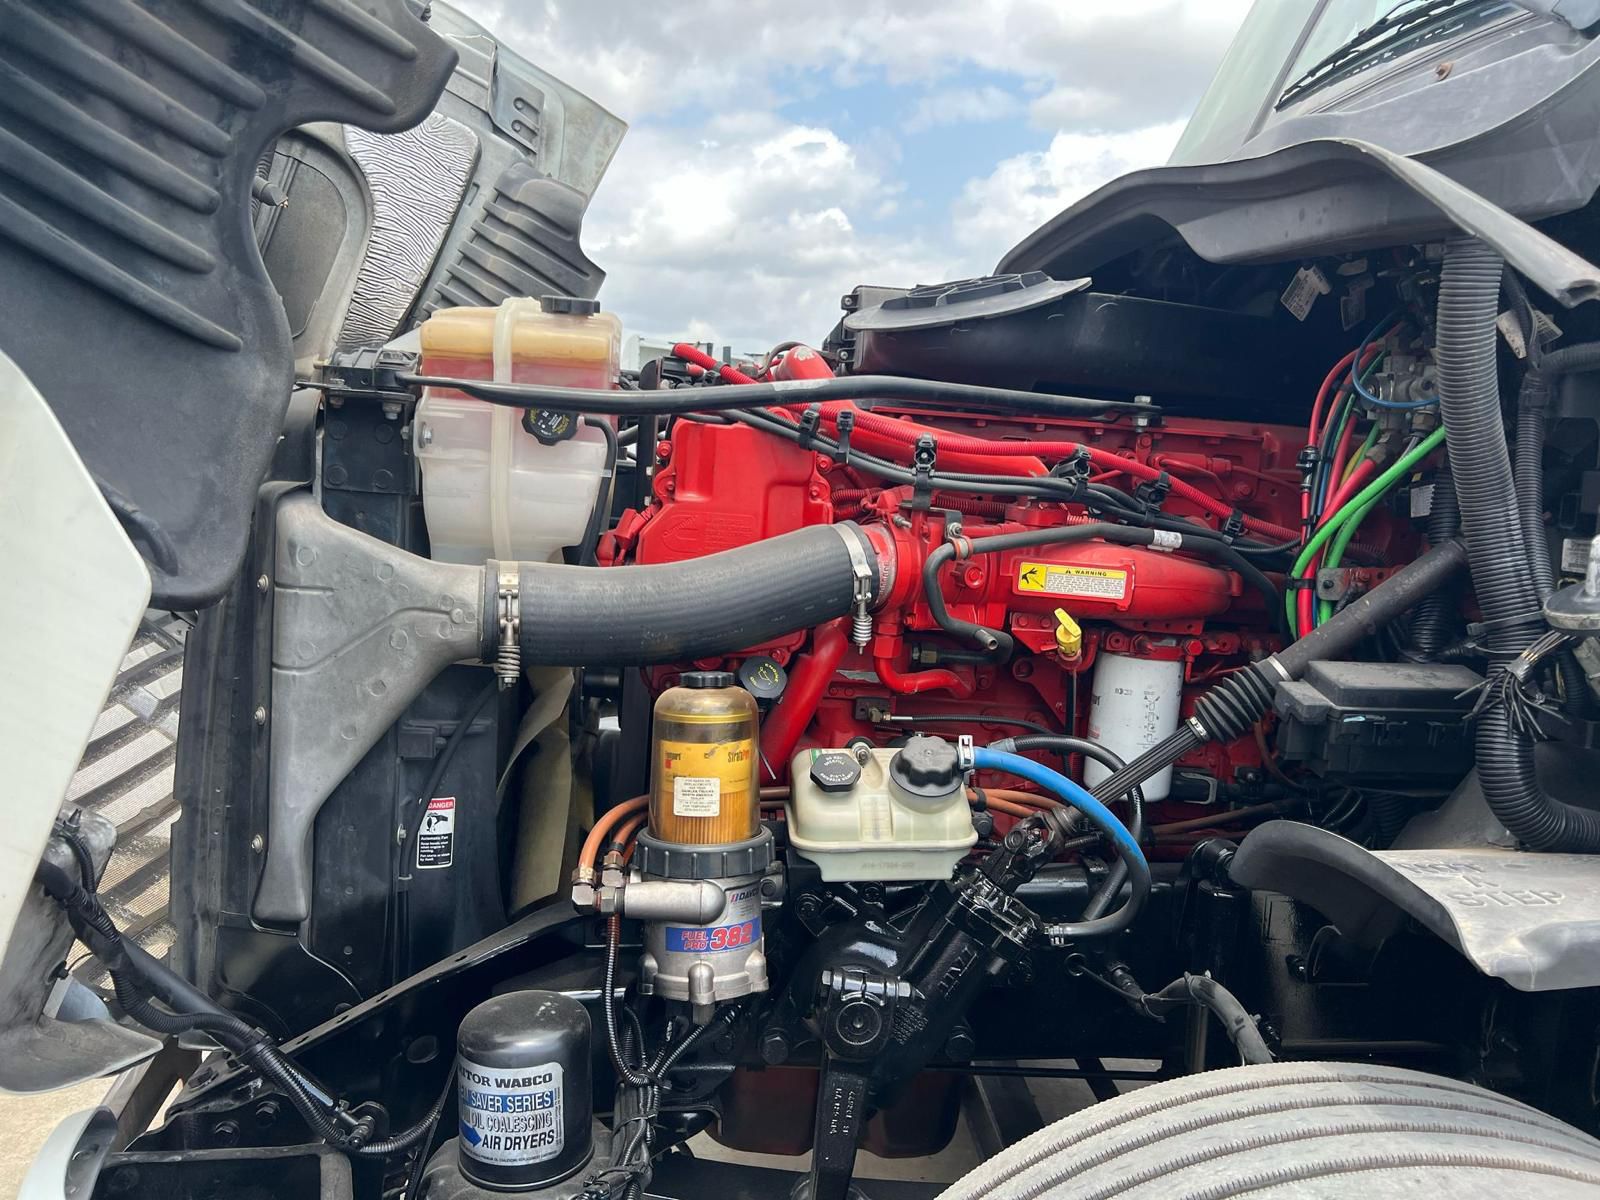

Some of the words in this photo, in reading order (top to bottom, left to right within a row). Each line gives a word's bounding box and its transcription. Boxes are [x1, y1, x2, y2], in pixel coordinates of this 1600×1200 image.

[764, 663, 779, 683] ENGINE
[428, 801, 454, 809] DANGER
[1447, 889, 1566, 907] STEP
[681, 930, 709, 940] FUEL
[710, 923, 754, 950] 382
[684, 940, 708, 950] PRO
[495, 1073, 553, 1088] WABCO
[471, 1091, 504, 1113] SAVER
[507, 1091, 553, 1114] SERIES
[470, 1110, 485, 1130] OIL
[487, 1111, 553, 1133] COALESCING
[482, 1134, 501, 1150] AIR
[504, 1129, 555, 1151] DRYERS
